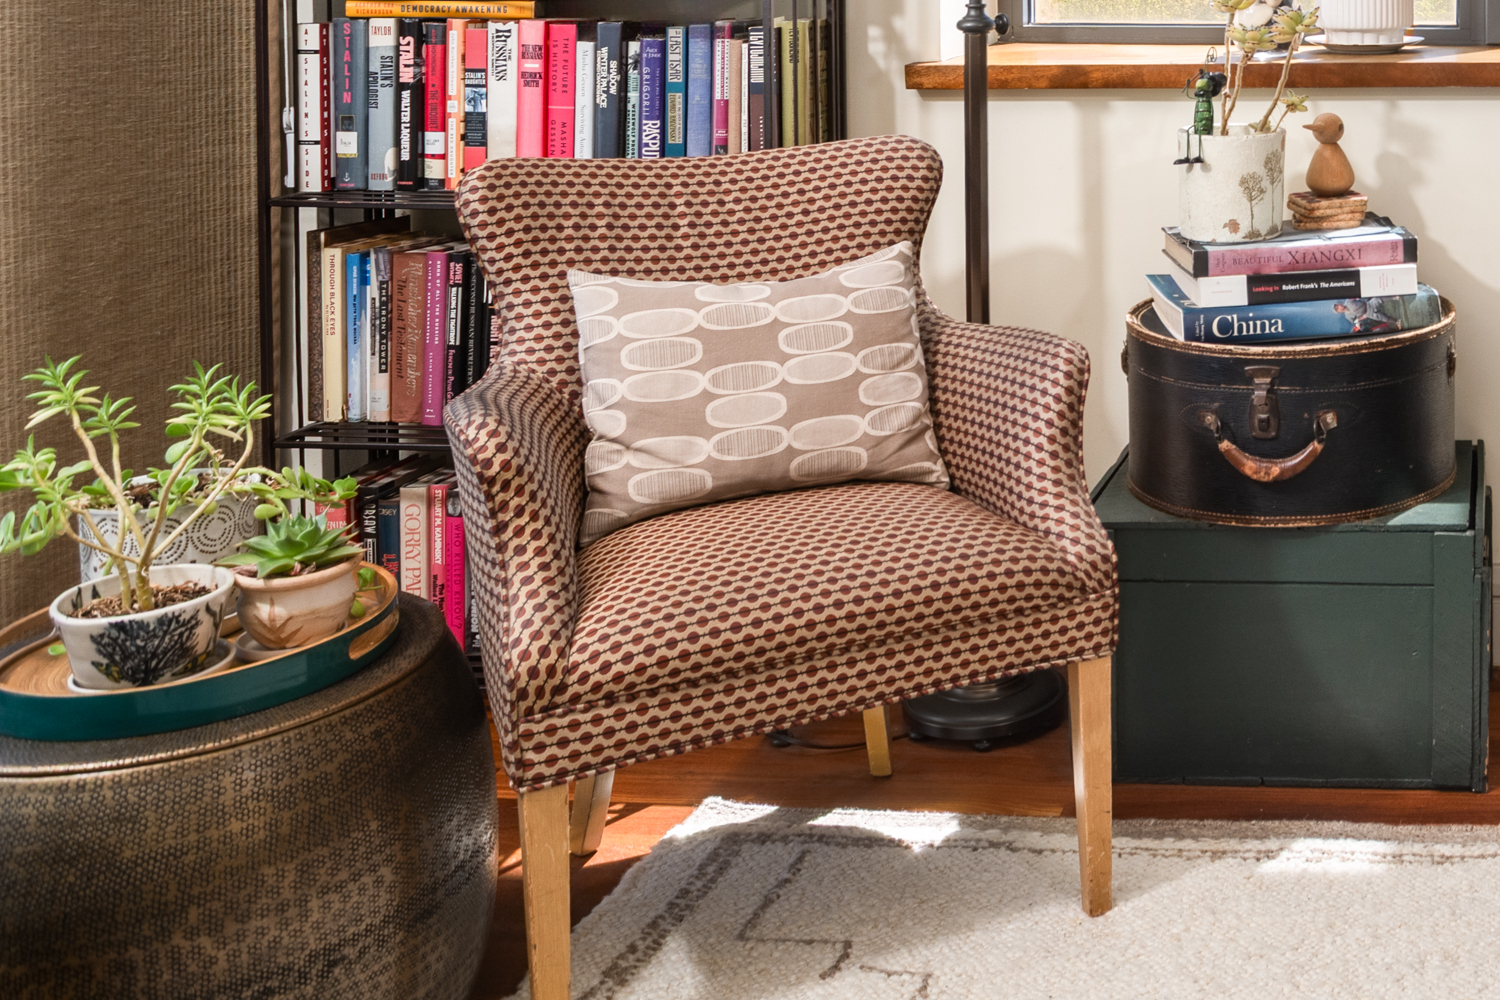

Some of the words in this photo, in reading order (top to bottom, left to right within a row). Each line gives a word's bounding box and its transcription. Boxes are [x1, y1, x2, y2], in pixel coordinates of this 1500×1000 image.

[401, 5, 451, 13] DEMOCRACY
[456, 5, 508, 13] AWAKENING
[371, 25, 391, 36] TAYLOR
[552, 40, 558, 48] IS
[399, 36, 414, 82] STALIN
[670, 36, 681, 56] LAST
[380, 56, 393, 88] STALIN'S
[670, 59, 681, 81] TSAR
[369, 71, 378, 109] APOLOGIST
[401, 90, 410, 122] WALTER
[400, 124, 410, 161] LAQUEUR
[1232, 255, 1284, 266] BEAUTIFUL
[1288, 248, 1362, 265] XIANGXI
[1212, 312, 1284, 338] China
[404, 504, 421, 563] GORKY
[405, 568, 421, 599] PAR
